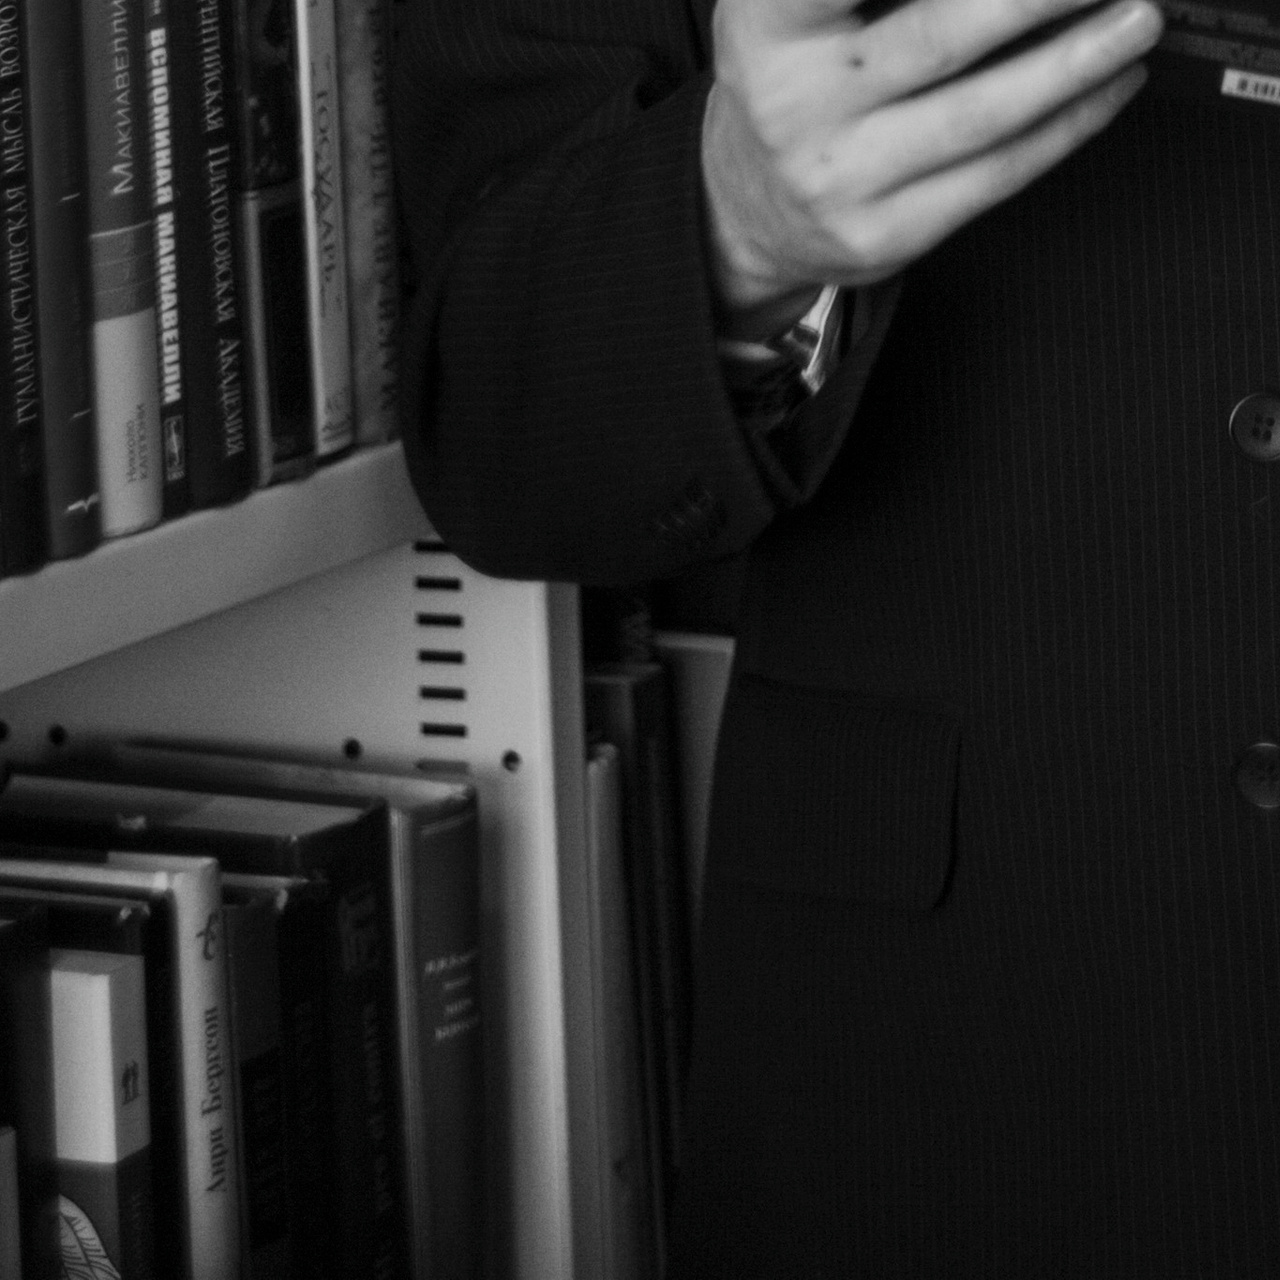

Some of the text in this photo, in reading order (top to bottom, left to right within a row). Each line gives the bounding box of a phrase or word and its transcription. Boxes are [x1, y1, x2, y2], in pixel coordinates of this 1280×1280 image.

[1, 86, 26, 175] МЫСЛЬ
[147, 26, 174, 206] ВСПОМИНАЯ
[5, 184, 40, 425] ГУМАНИСТИЧЕСКАЯ
[154, 211, 182, 405] МАКИАВЕЛЛИ
[201, 1005, 224, 1118] Бергсон
[205, 1126, 229, 1193] Анри
